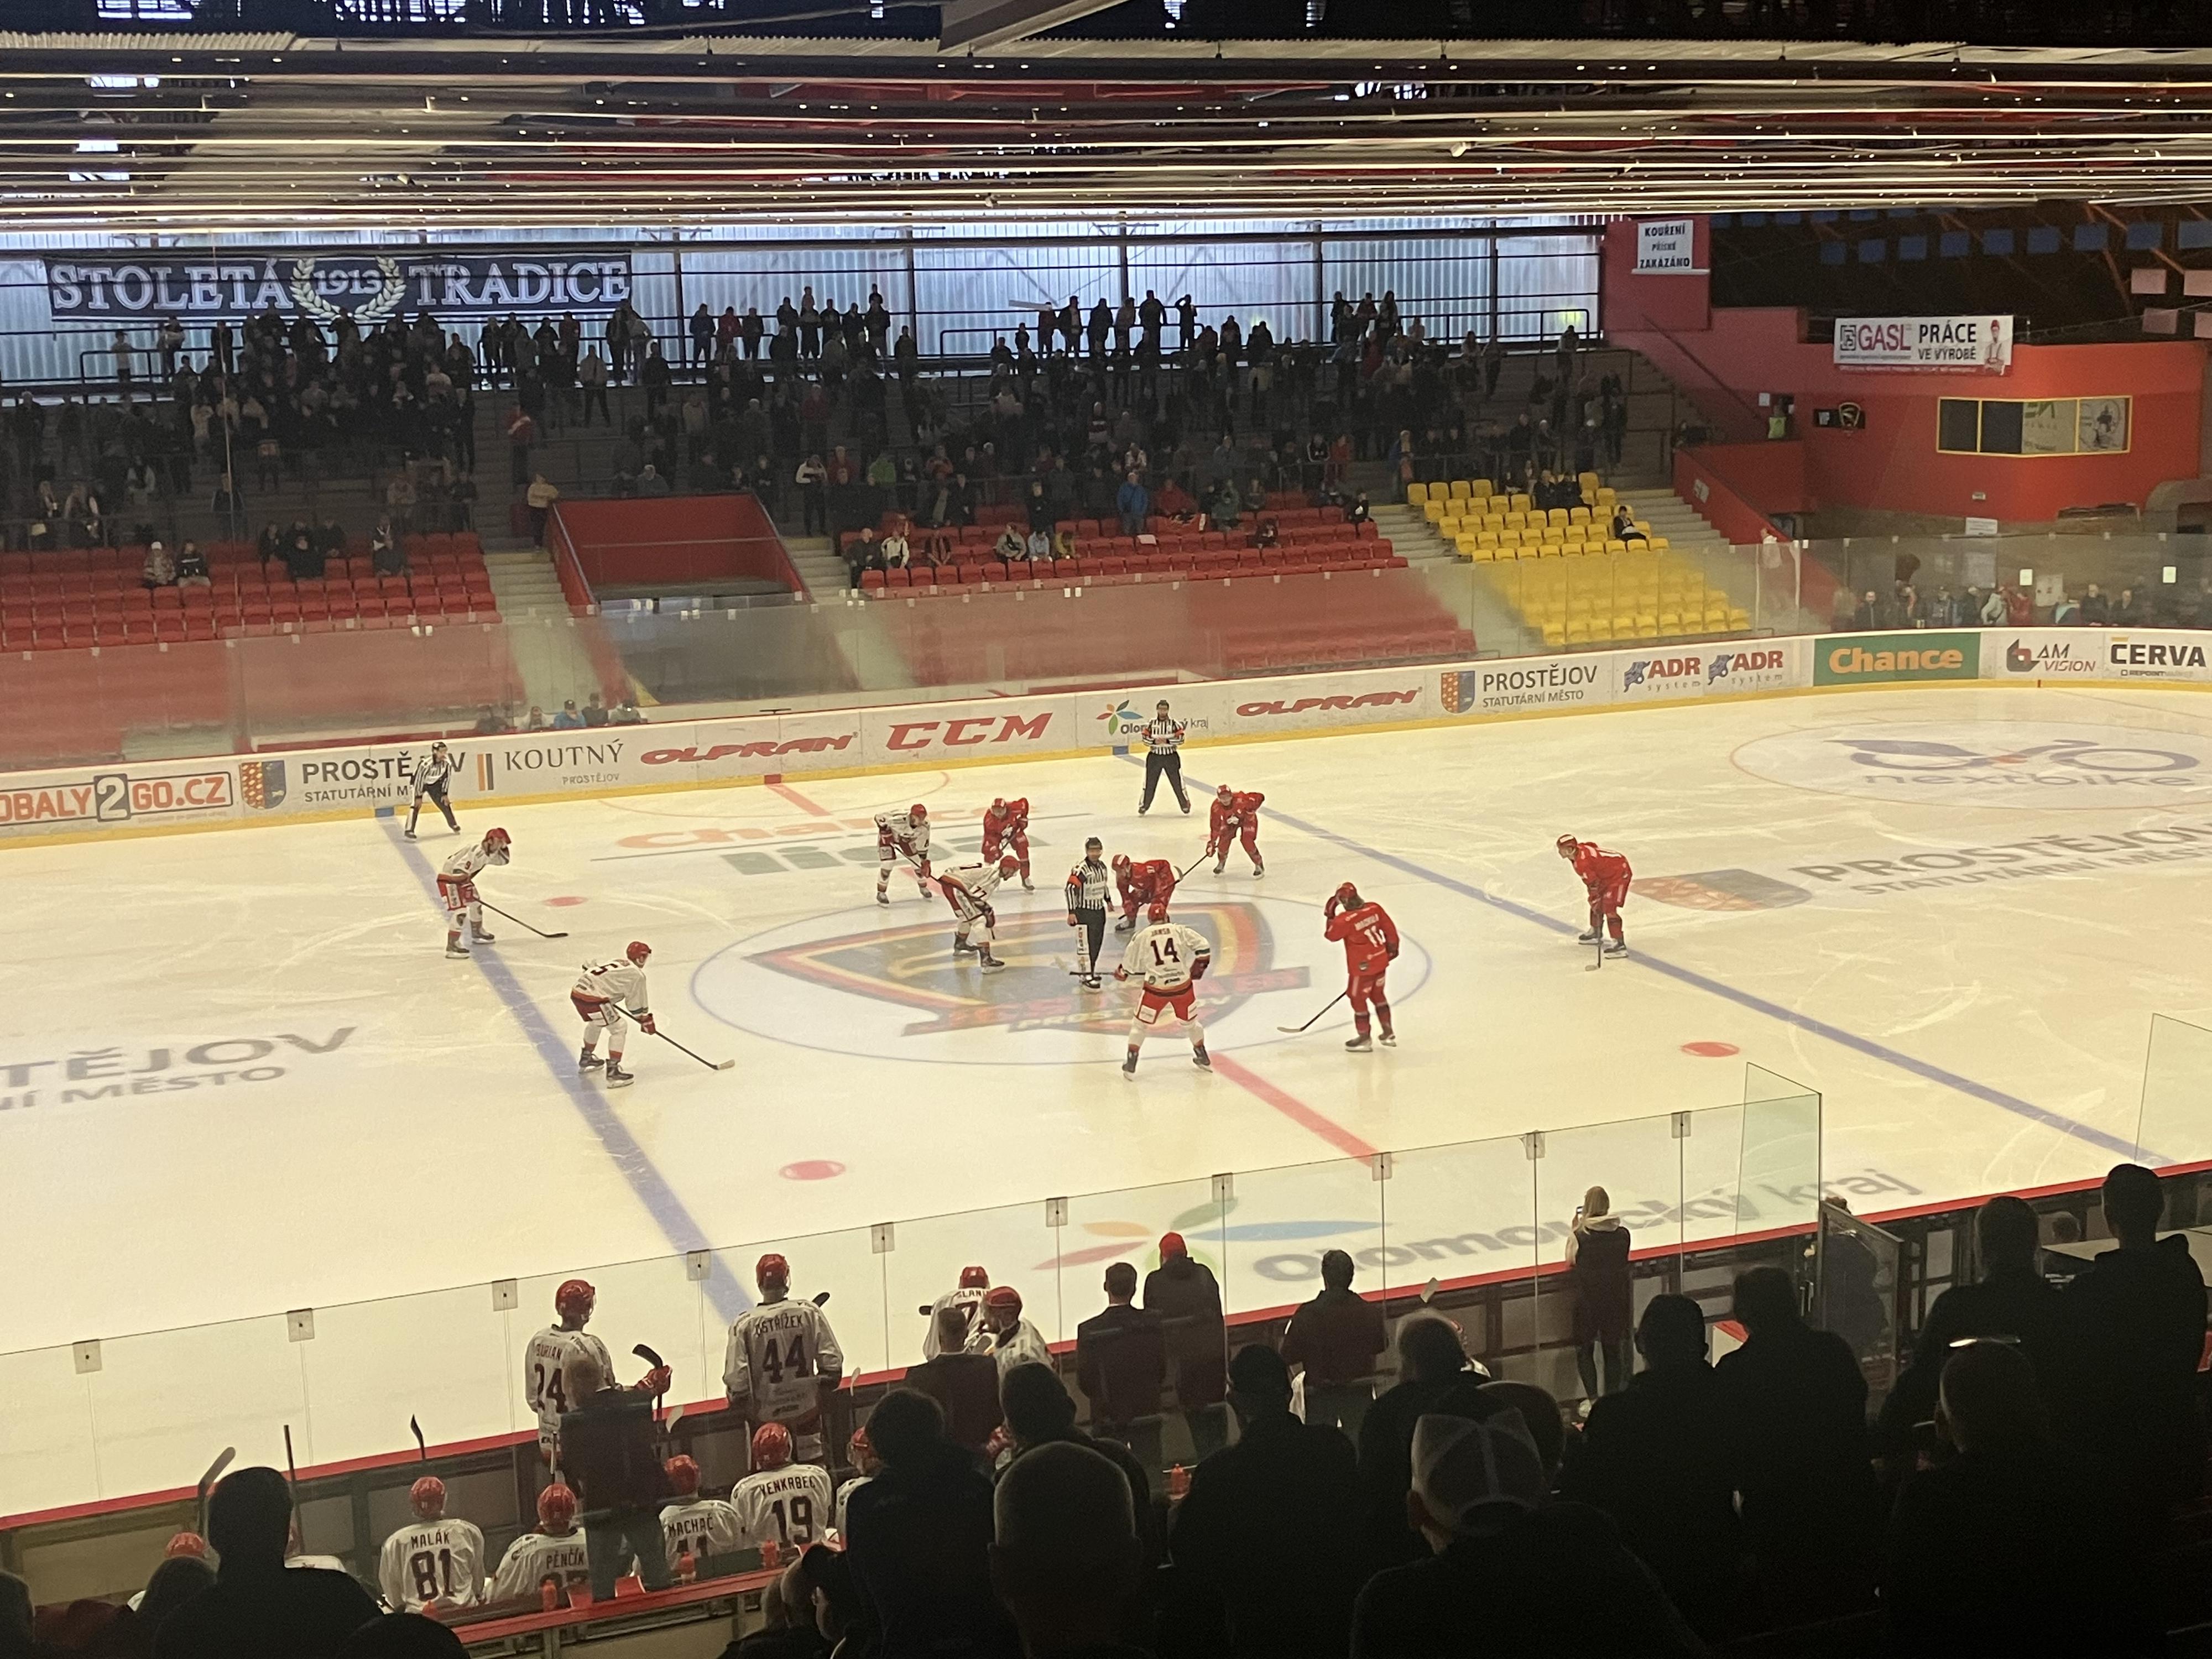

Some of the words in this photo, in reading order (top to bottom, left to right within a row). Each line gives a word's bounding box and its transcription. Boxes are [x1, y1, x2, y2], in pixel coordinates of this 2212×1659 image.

[1645, 222, 1686, 237] KOUŘENÍ
[1640, 254, 1690, 269] ZAKÁZÁNO
[51, 257, 293, 310] STOLETÁ
[313, 268, 382, 294] 1913
[409, 261, 631, 307] TRADICE
[1858, 324, 1911, 351] GASL
[1918, 319, 1977, 343] PRÁCE
[1918, 348, 1931, 360] VE
[1731, 650, 1784, 673] ADR
[1829, 647, 1963, 674] Chance
[2037, 643, 2070, 659] AM
[2110, 644, 2207, 668] CERVA
[1483, 664, 1598, 692] PROSTĚJOV
[1647, 657, 1701, 680] ADR
[2043, 660, 2096, 672] VISION
[1235, 689, 1418, 717] OLPRAN
[1483, 692, 1546, 708] STATUTÁRNÍ
[1548, 689, 1584, 703] MĚSTO
[886, 712, 1053, 752] CCM
[1190, 717, 1209, 729] kraj
[505, 738, 624, 771] KOUTNÝ
[640, 734, 855, 765] OLPRAN
[302, 750, 466, 784] PROSTĚV
[562, 772, 620, 786] PROSTĚJOV
[1865, 774, 2196, 787] nextbike
[305, 783, 392, 803] STATUTÁRNÍ
[1150, 937, 1181, 966] 14
[763, 1333, 810, 1384] 44
[759, 1475, 816, 1496] VENKRBEC
[667, 1513, 714, 1538] MACHAČ
[771, 1495, 813, 1549] 19
[410, 1528, 450, 1550] MALÁK
[409, 1548, 455, 1601] 81
